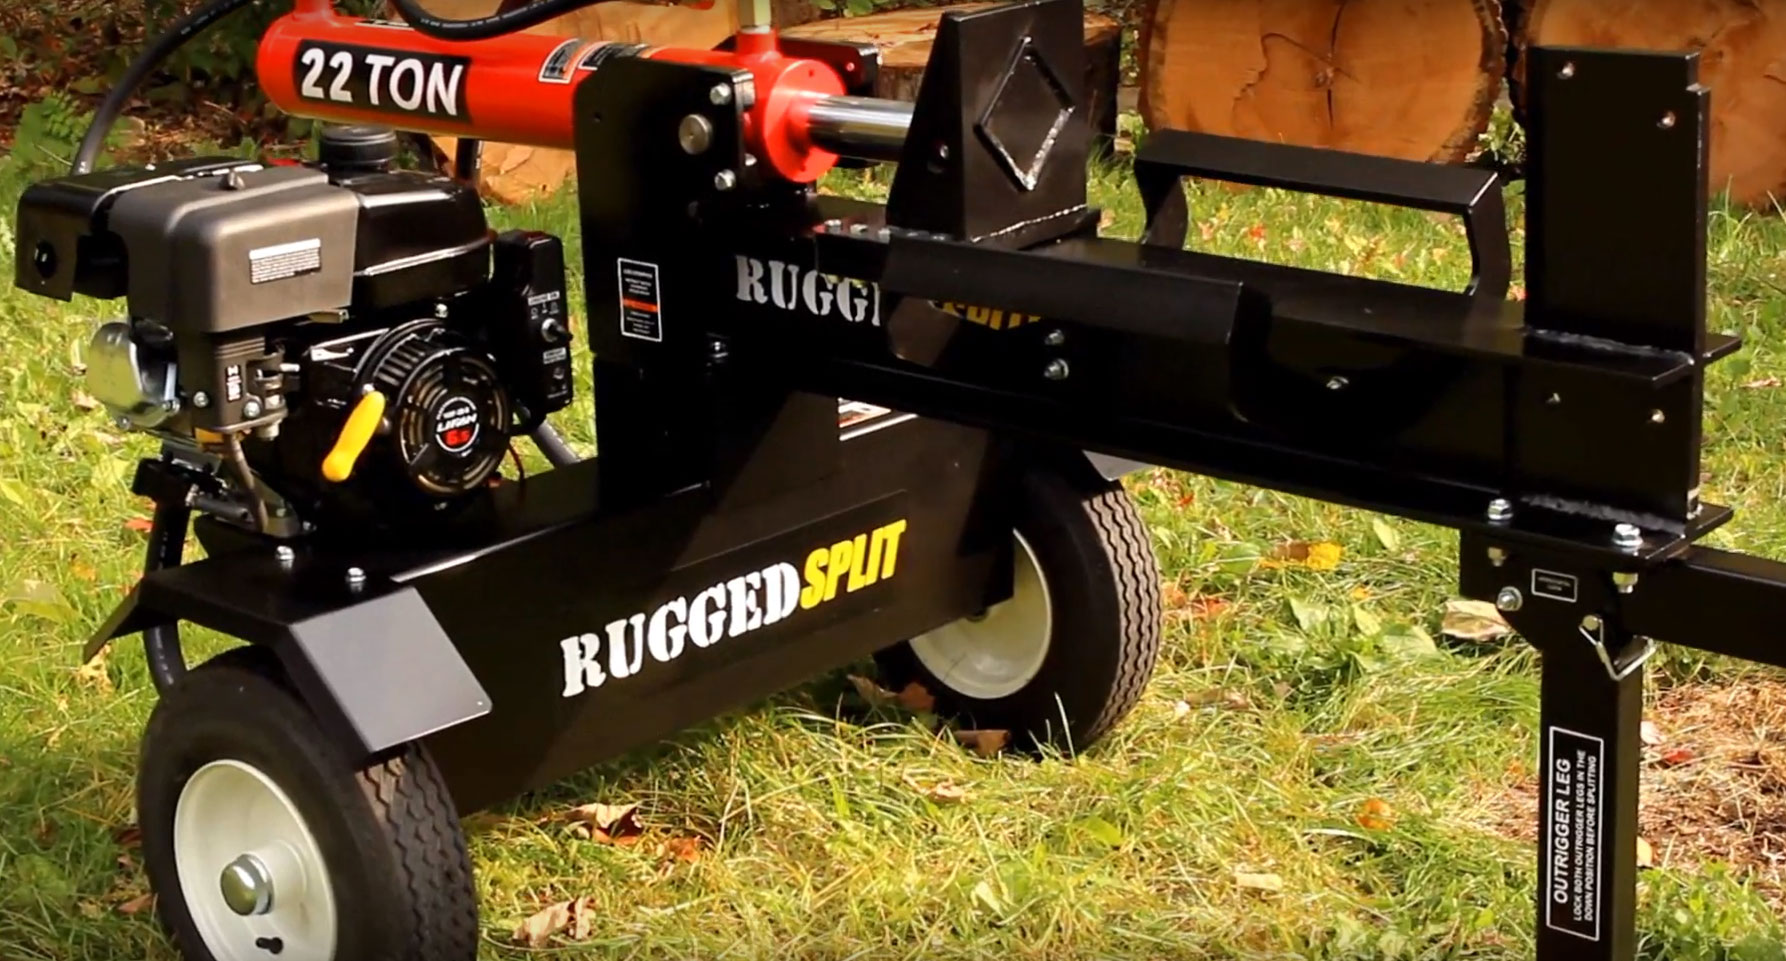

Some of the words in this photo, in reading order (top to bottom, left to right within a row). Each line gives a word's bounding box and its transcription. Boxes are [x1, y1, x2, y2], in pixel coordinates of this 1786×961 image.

[301, 48, 354, 102] 22
[364, 54, 463, 117] TON
[735, 254, 881, 328] RUGG
[1555, 758, 1572, 796] LEG
[1576, 749, 1586, 769] THE
[1576, 770, 1586, 782] IN
[1575, 783, 1585, 809] LEGS
[1586, 755, 1597, 805] SPLITTING
[1574, 810, 1584, 866] OUTRIGGER
[1585, 806, 1596, 846] BEFORE
[1553, 798, 1571, 904] OUTRIGGER
[1584, 846, 1595, 891] POSITION
[1573, 867, 1583, 894] BOTH
[1573, 895, 1582, 921] LOCK
[1583, 891, 1594, 922] DOWN
